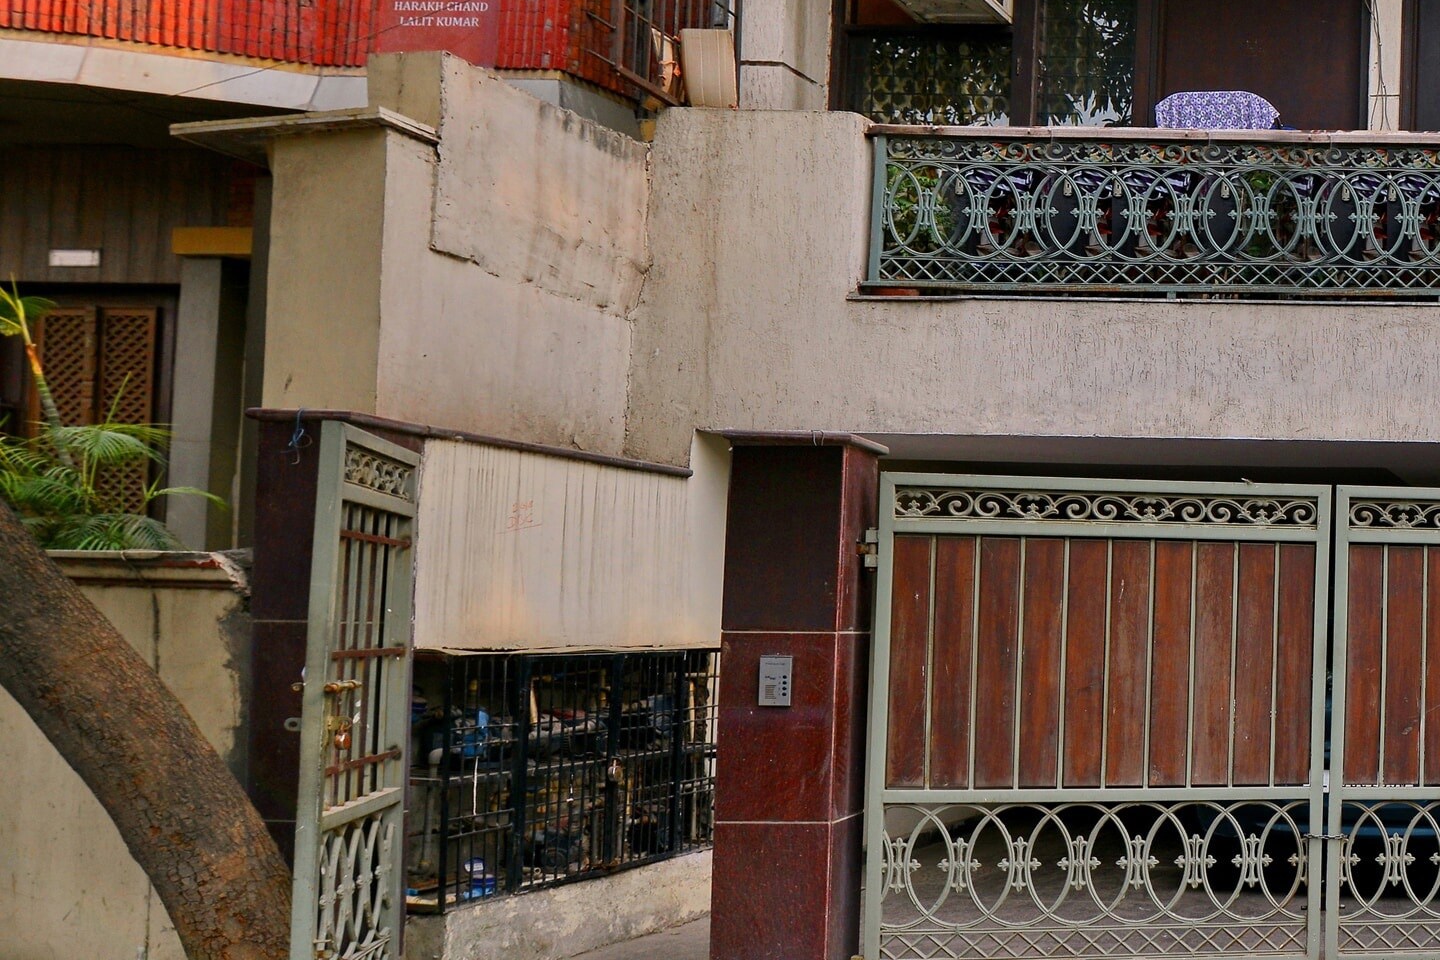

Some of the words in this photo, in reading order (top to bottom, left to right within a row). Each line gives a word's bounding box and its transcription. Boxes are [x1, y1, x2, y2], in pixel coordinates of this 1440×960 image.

[394, 1, 444, 12] HARAKH
[446, 1, 489, 12] CHAND
[400, 16, 434, 27] LALIT
[436, 16, 479, 27] KUMAR
